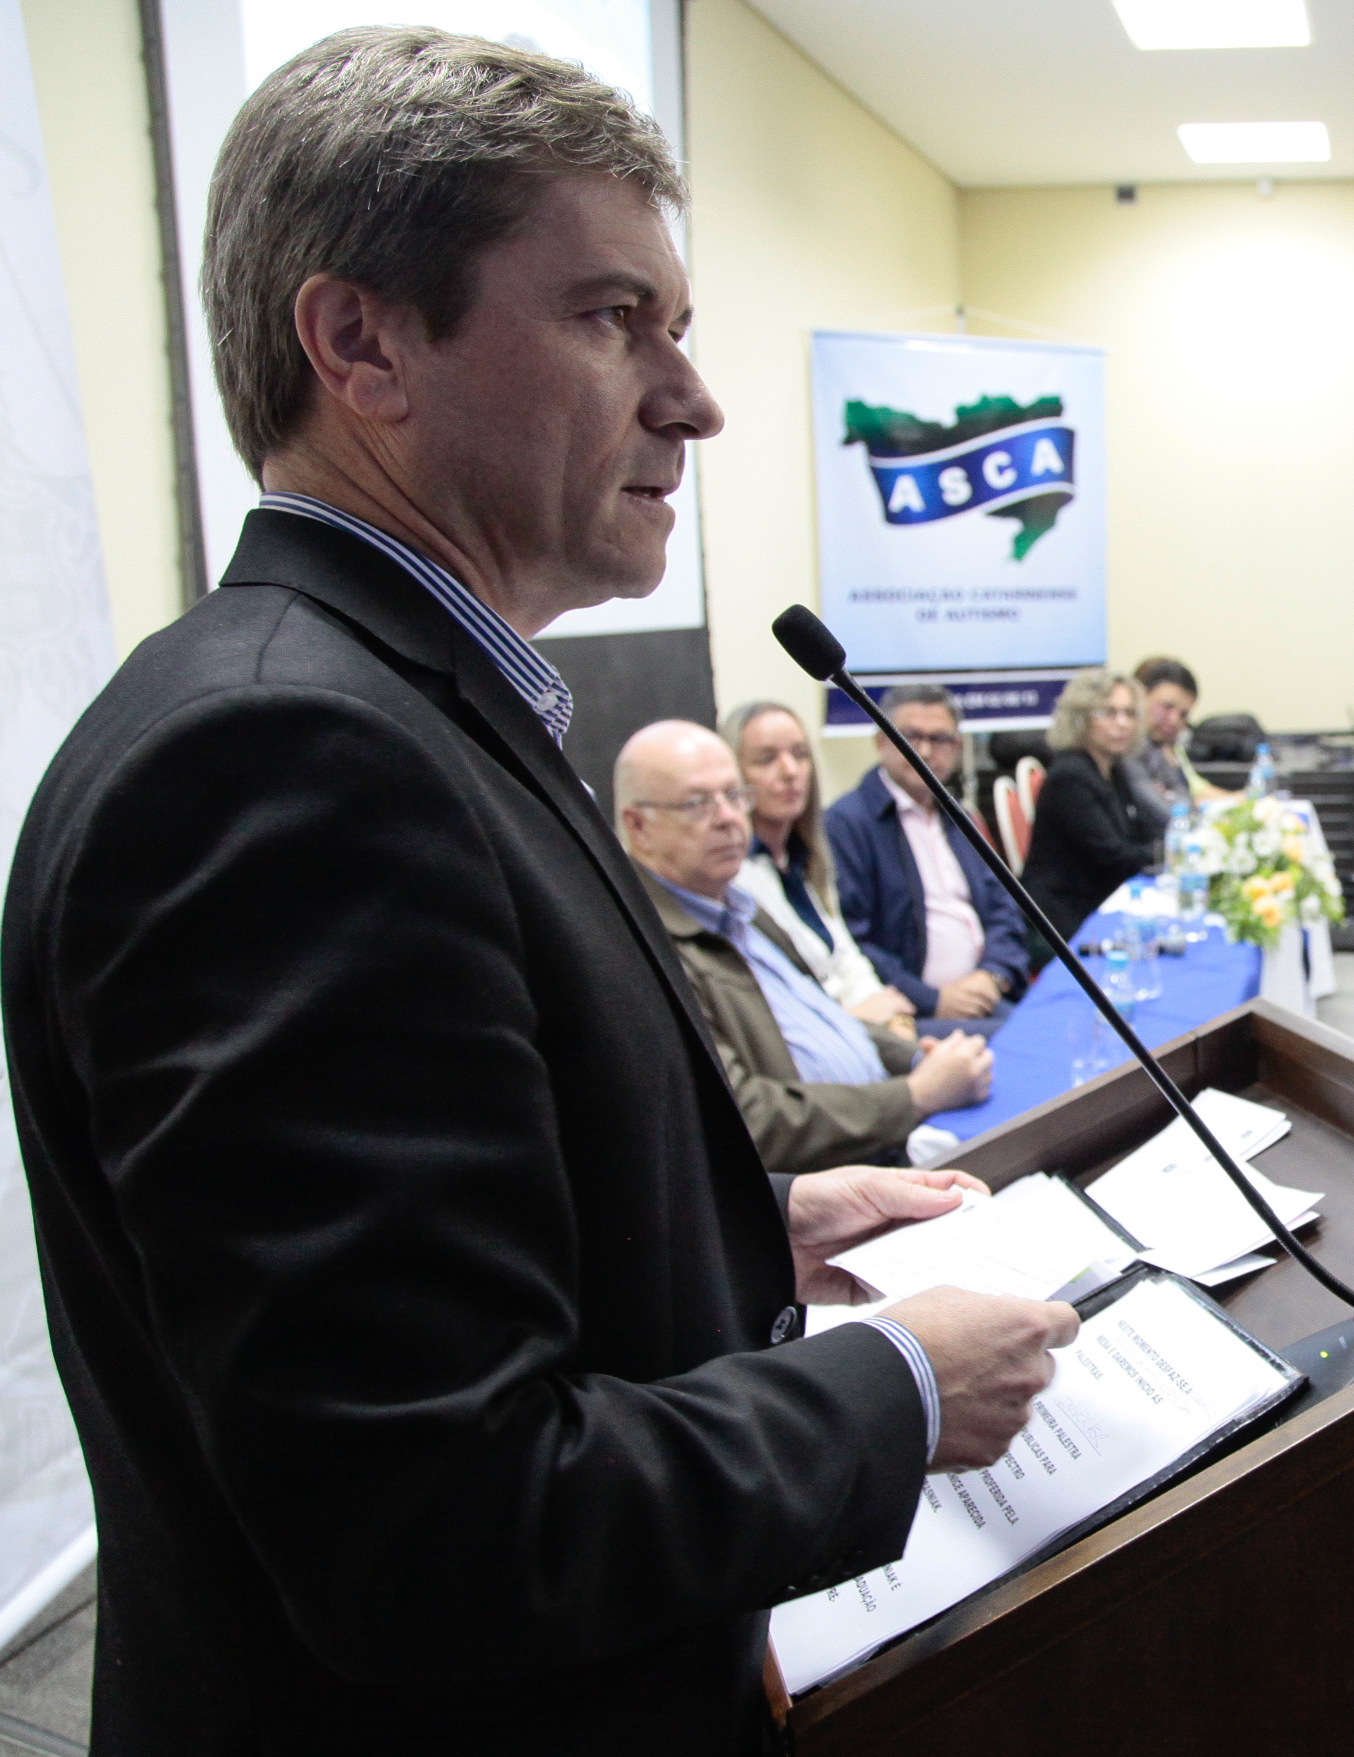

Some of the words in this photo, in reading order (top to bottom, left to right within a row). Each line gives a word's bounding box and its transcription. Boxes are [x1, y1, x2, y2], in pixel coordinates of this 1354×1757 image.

[888, 438, 1065, 513] ASCA
[1107, 1346, 1116, 1355] E
[1112, 1351, 1139, 1378] DAREMOS
[1132, 1333, 1160, 1361] MOMENTO
[1156, 1357, 1188, 1390] DESFAZ-SE
[1034, 1401, 1058, 1430] PRIMEIRA
[1054, 1428, 1082, 1460] PALESTRA
[1039, 1456, 1057, 1476] PARA
[957, 1490, 986, 1529] APARECIDA
[980, 1469, 1008, 1507] PROFERIDA
[1002, 1505, 1019, 1525] PELA
